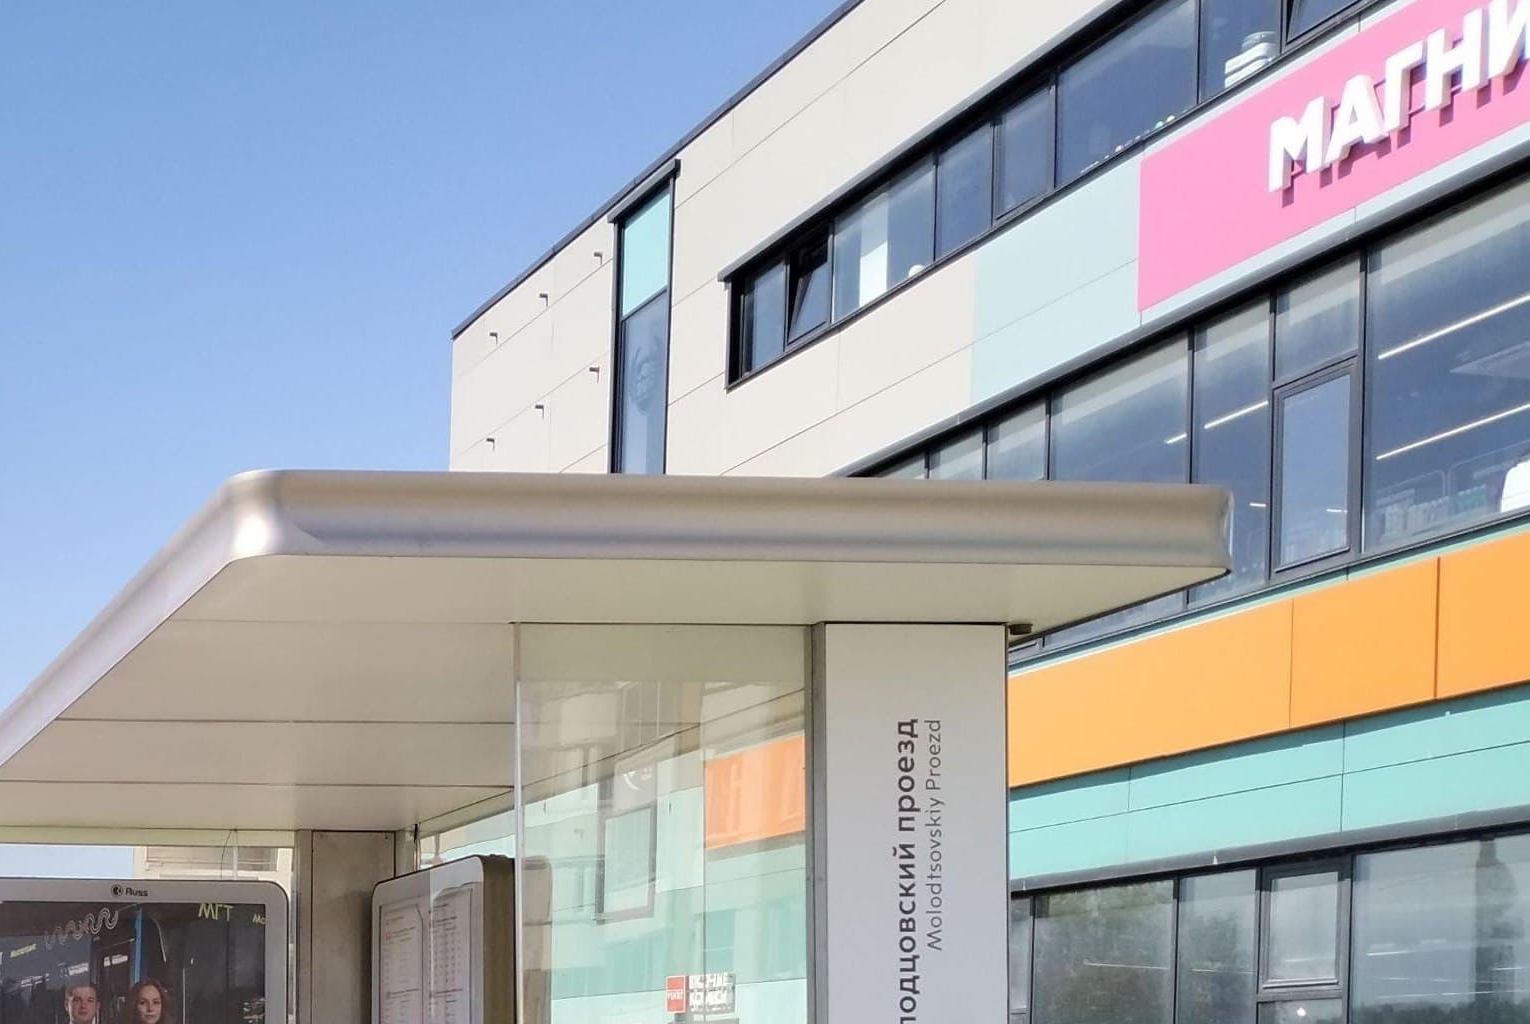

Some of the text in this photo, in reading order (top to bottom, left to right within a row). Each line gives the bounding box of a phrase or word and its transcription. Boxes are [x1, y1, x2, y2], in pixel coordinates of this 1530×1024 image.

[897, 718, 921, 832] проезд
[924, 719, 946, 951] Molodtsovskiy Proezd
